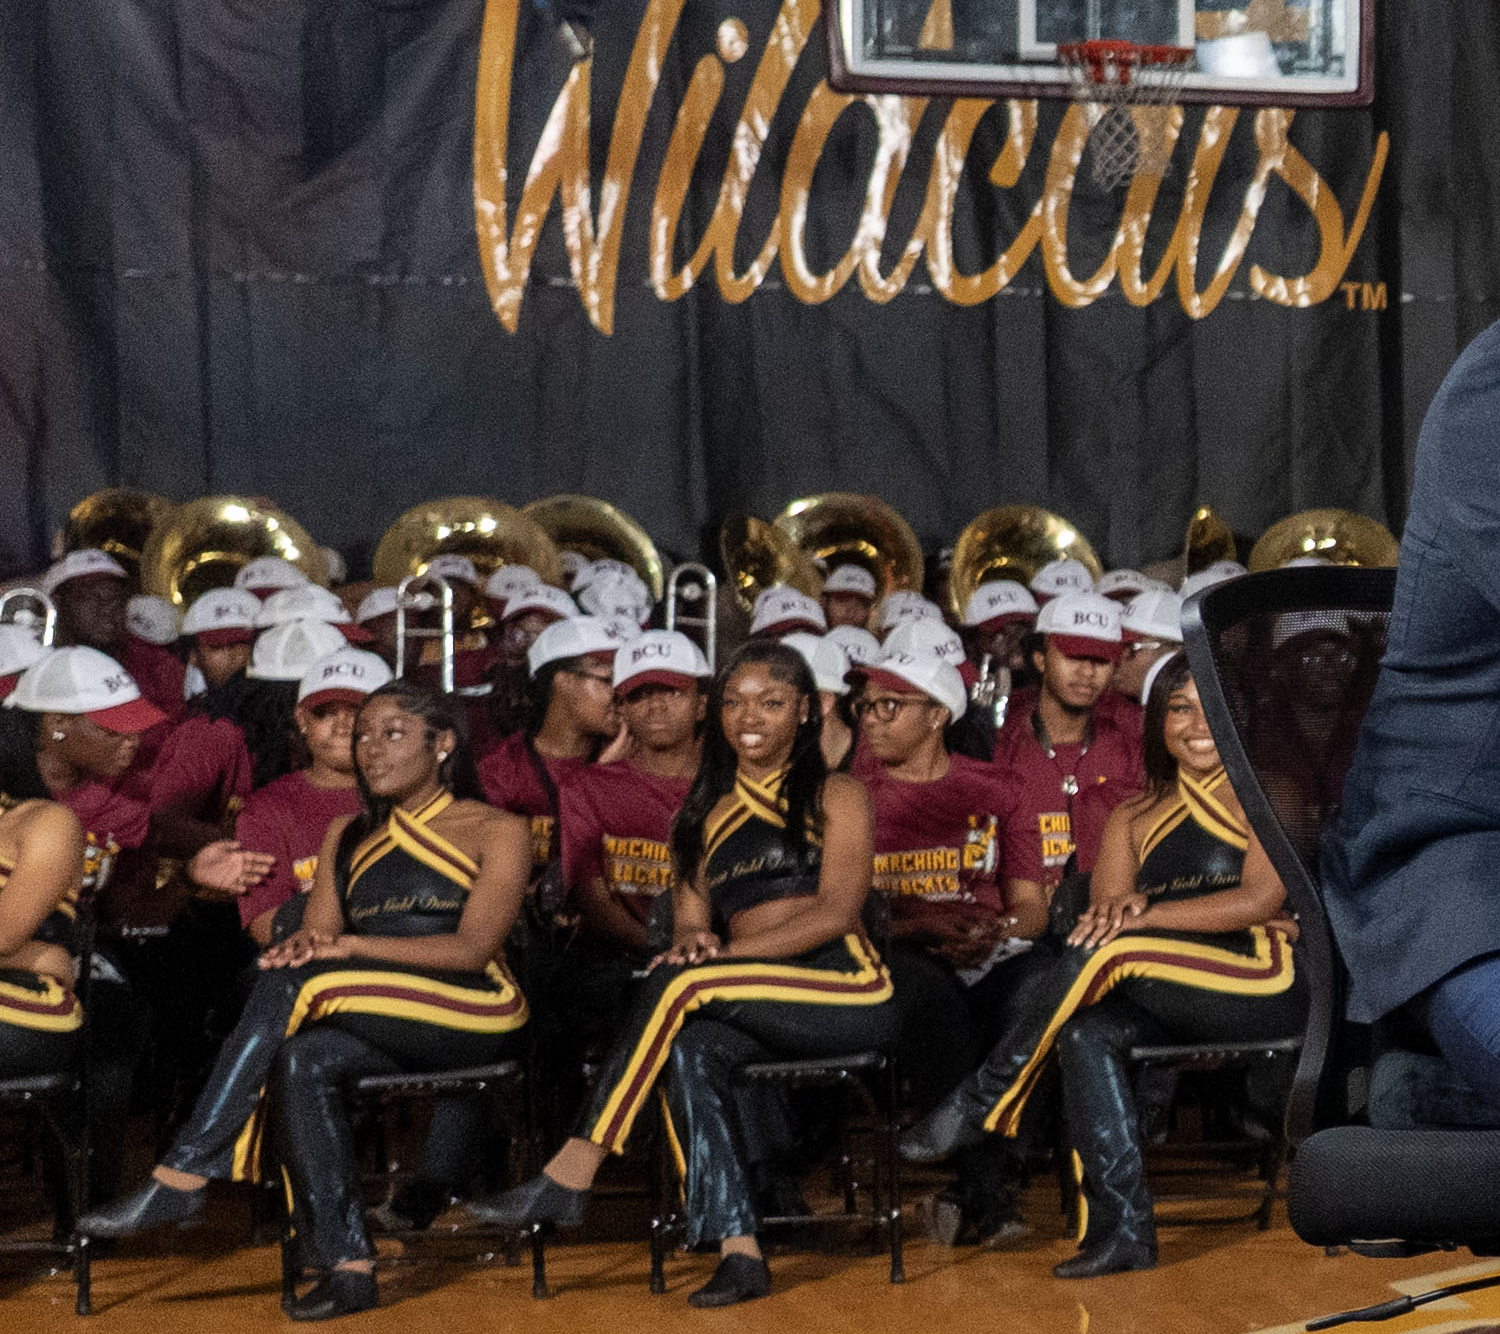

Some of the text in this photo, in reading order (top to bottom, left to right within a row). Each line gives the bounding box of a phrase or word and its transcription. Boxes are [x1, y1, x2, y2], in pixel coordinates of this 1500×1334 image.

[1341, 283, 1388, 311] TM
[1072, 612, 1110, 628] BCU
[632, 642, 672, 661] BCU
[322, 664, 366, 679] BCU
[873, 847, 960, 874] MARCHING
[873, 870, 960, 896] DCATS
